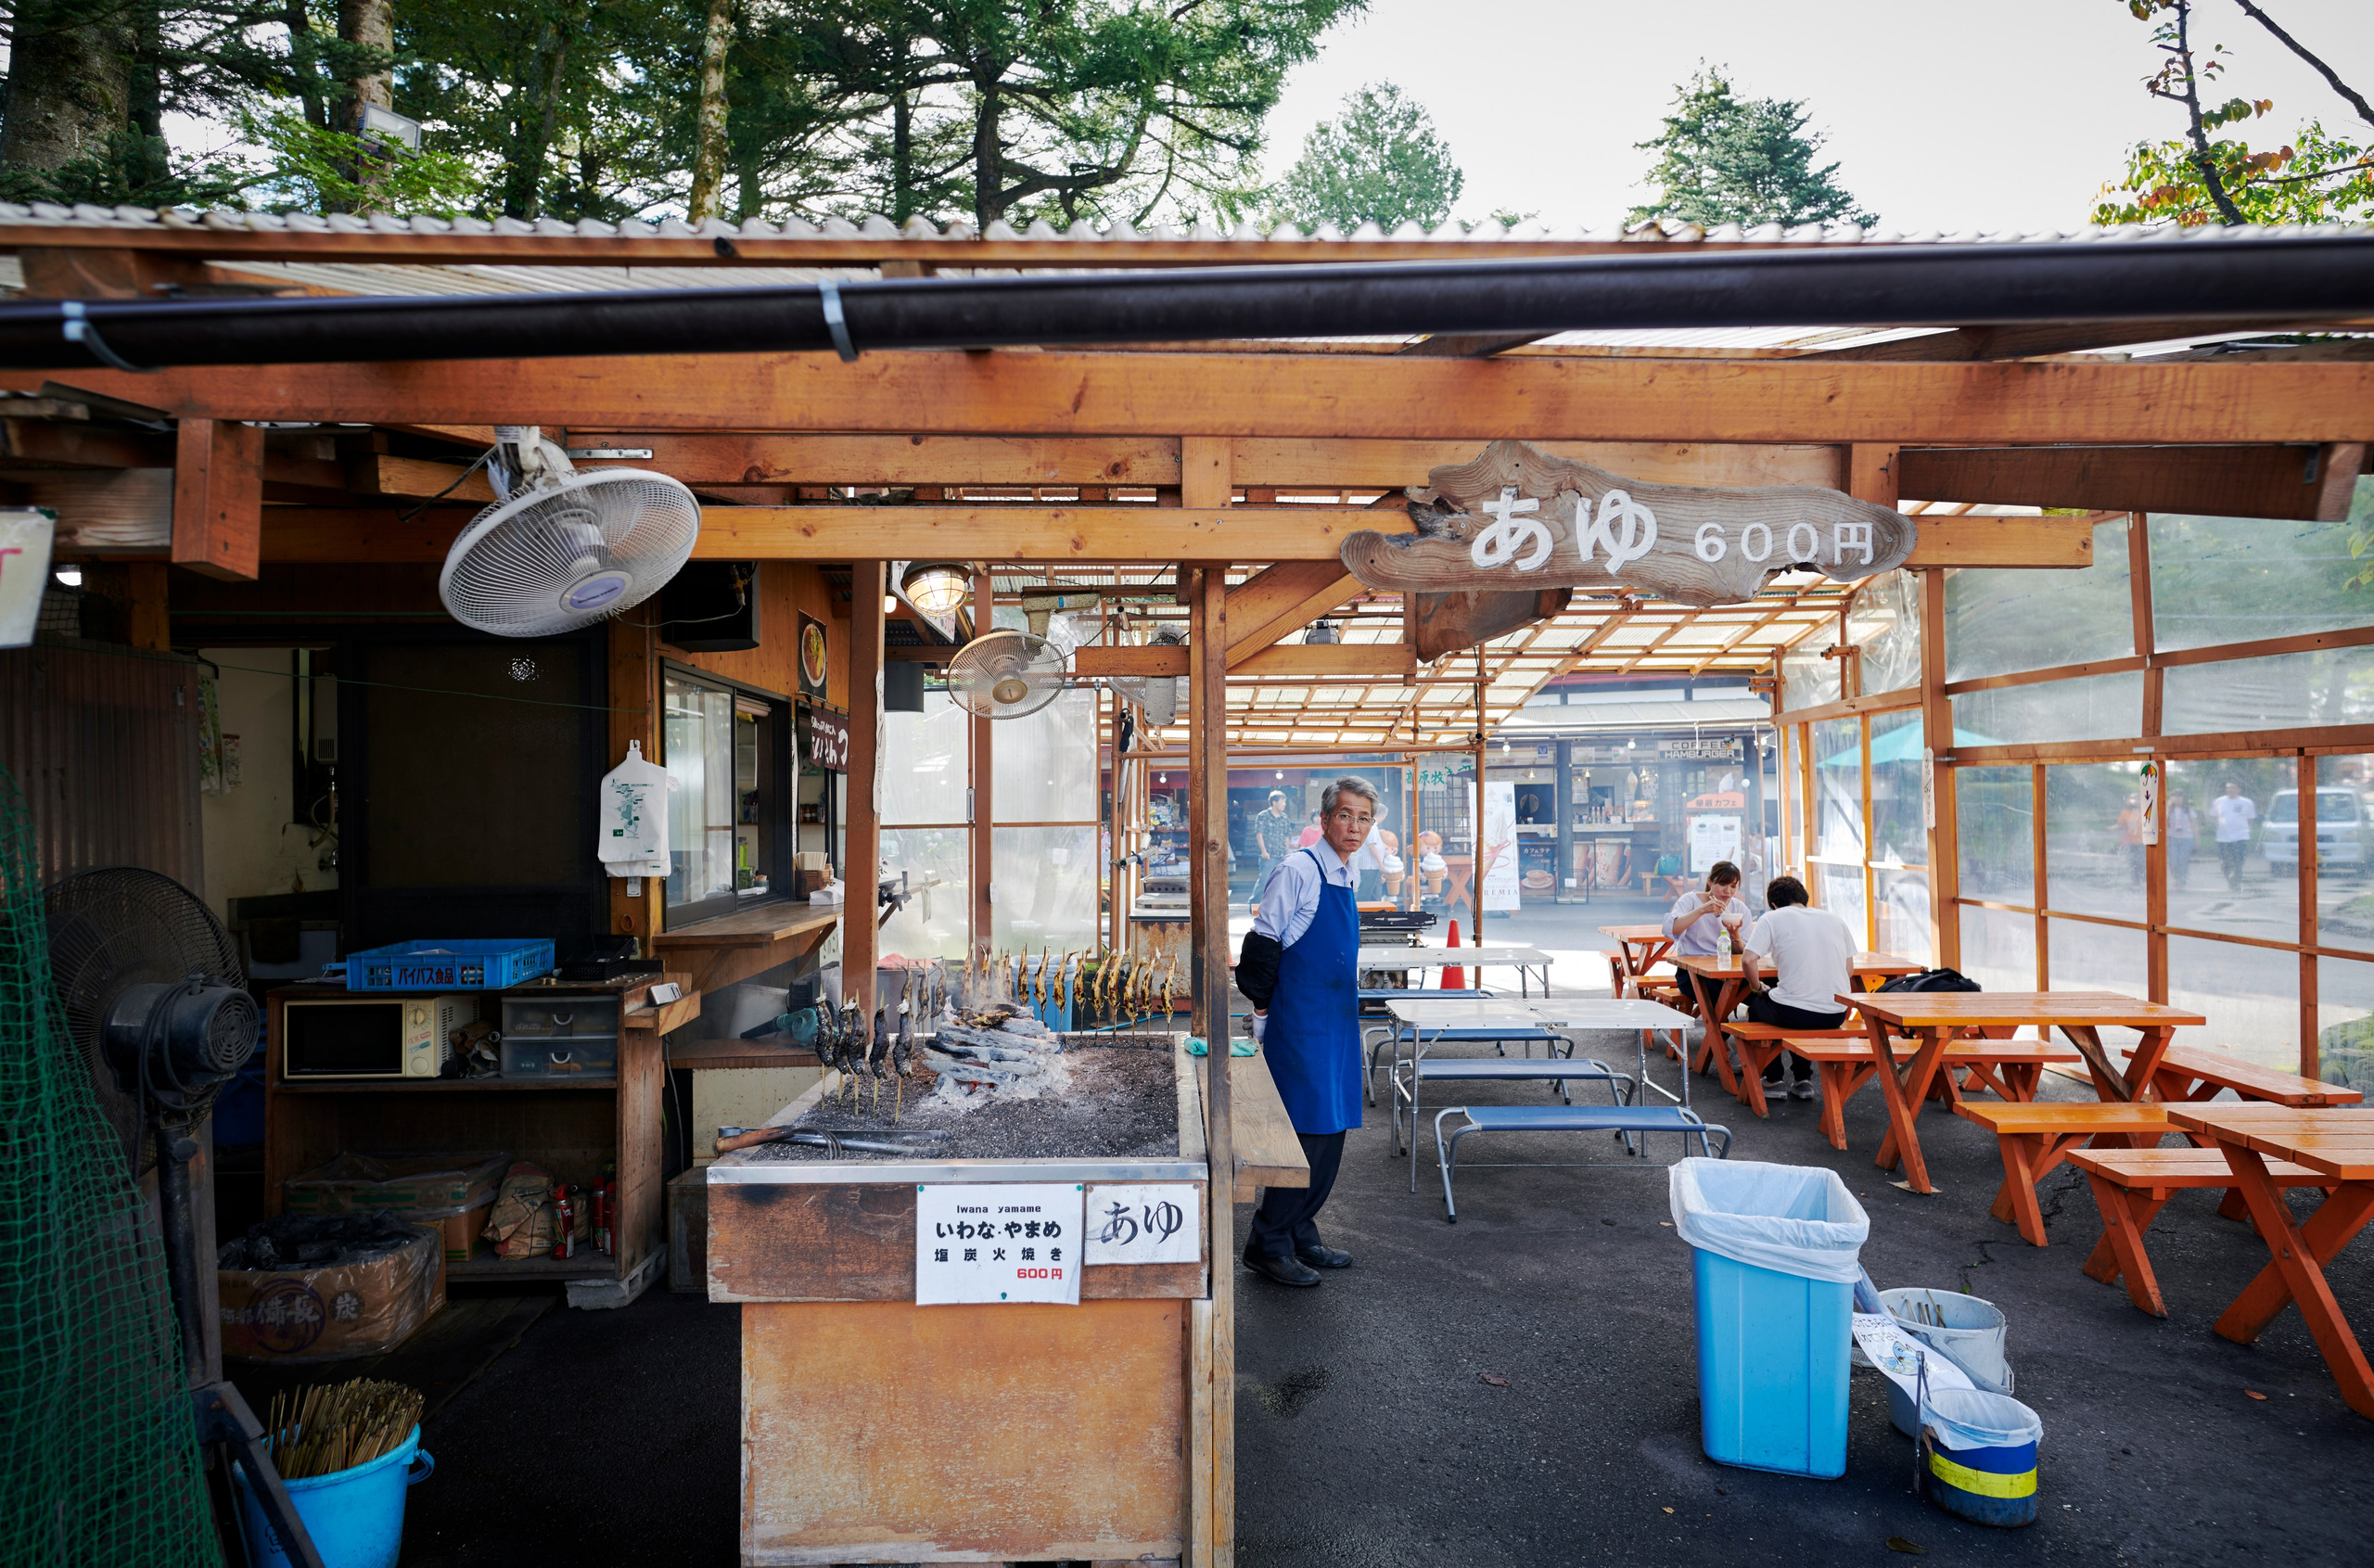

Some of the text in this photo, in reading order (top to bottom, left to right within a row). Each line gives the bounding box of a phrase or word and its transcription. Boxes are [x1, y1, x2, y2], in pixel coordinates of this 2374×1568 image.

[1470, 485, 1874, 574] あゆ 600円
[1671, 741, 1728, 749] COFFEE
[1665, 749, 1735, 759] HAMBURGER
[956, 1205, 1041, 1215] Iwana yamame
[1100, 1200, 1184, 1246] あゆ
[934, 1246, 1063, 1262] 塩炭火焼き
[1016, 1268, 1063, 1281] 600円
